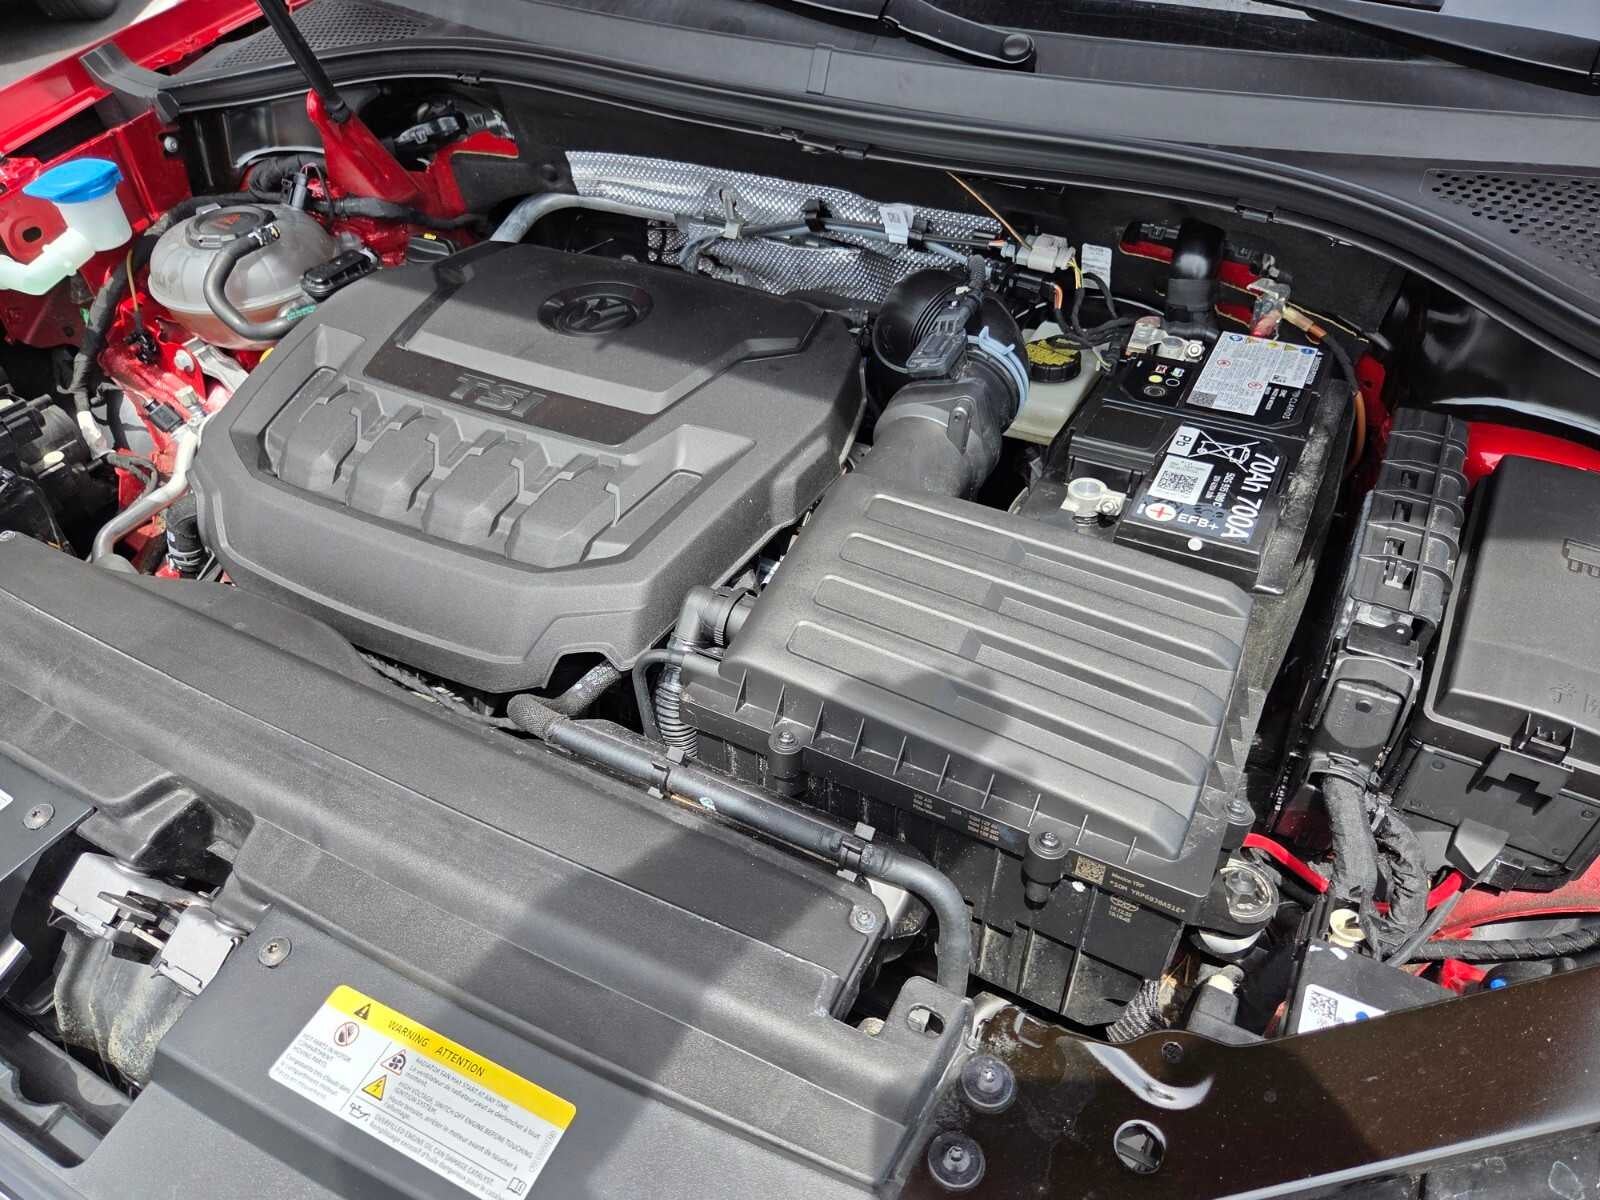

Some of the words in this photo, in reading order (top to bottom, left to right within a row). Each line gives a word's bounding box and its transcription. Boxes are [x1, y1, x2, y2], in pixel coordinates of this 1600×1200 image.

[450, 373, 547, 417] TSI
[1174, 434, 1192, 447] Pb
[1242, 453, 1279, 492] 70Ah
[1177, 513, 1218, 530] EFB+
[1221, 495, 1262, 537] 700A
[388, 1020, 429, 1047] WARNING
[434, 1046, 485, 1076] ATTENTION
